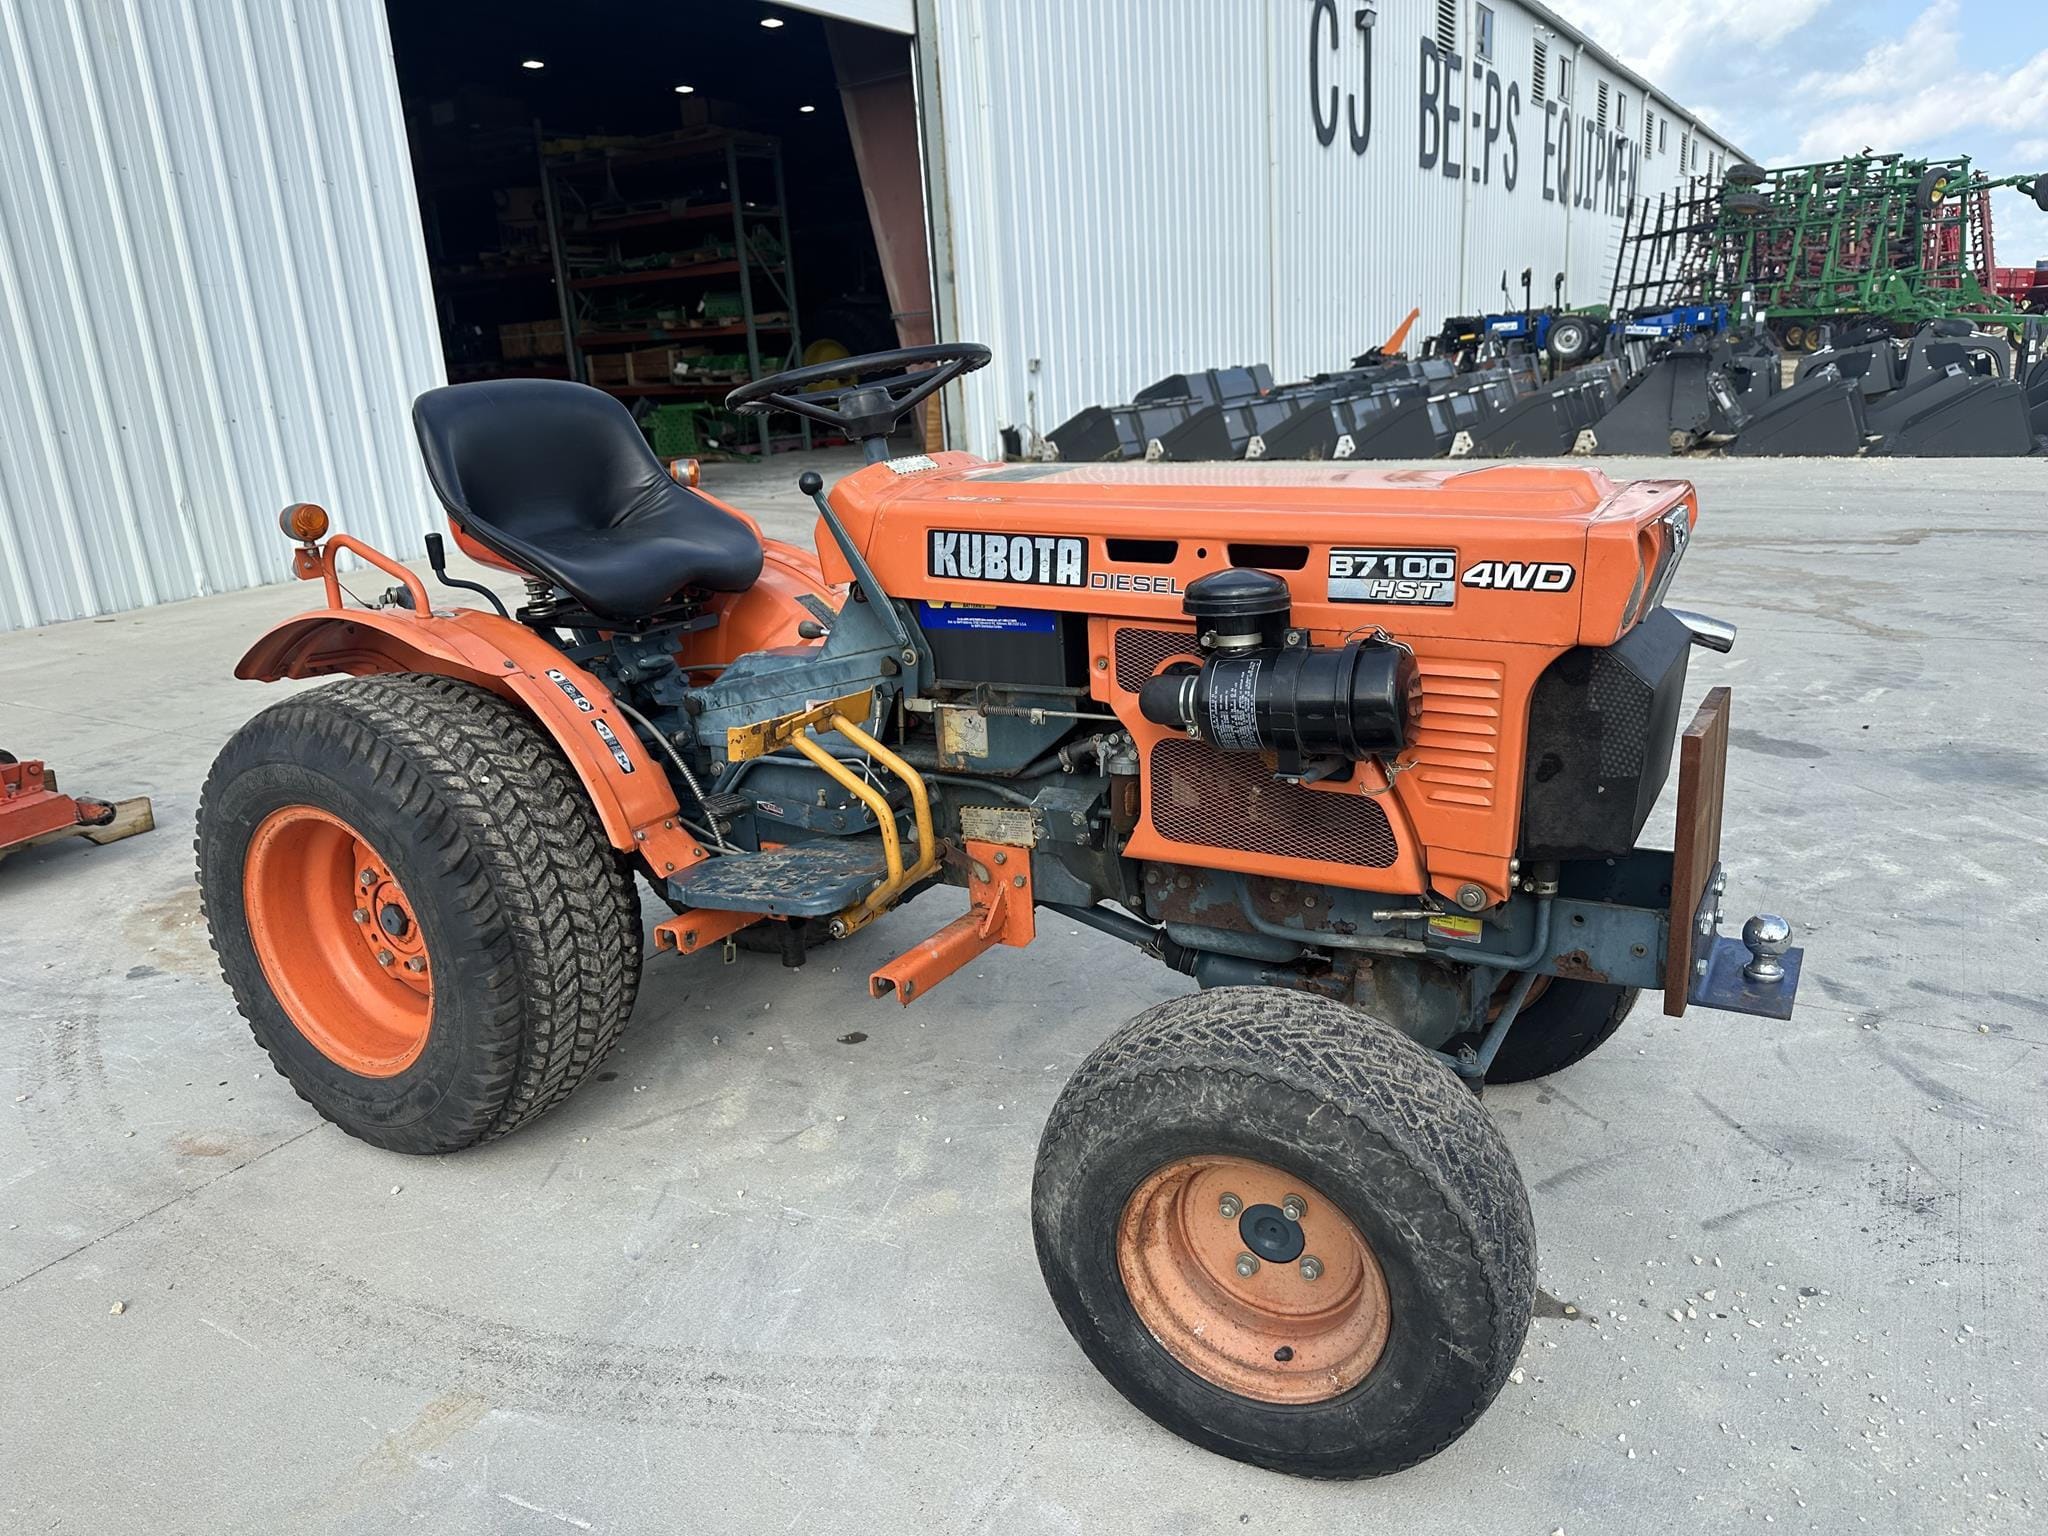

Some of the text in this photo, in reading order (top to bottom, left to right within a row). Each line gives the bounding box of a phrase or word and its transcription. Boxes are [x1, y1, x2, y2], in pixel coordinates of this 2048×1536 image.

[1310, 0, 1371, 155] CJ
[1543, 99, 1641, 219] EQUIPMEN
[934, 532, 1081, 585] KUBOTA
[1329, 556, 1455, 578] B7100
[1090, 574, 1184, 594] DIESEL
[1461, 561, 1575, 592] 4WD
[1370, 581, 1442, 599] HST
